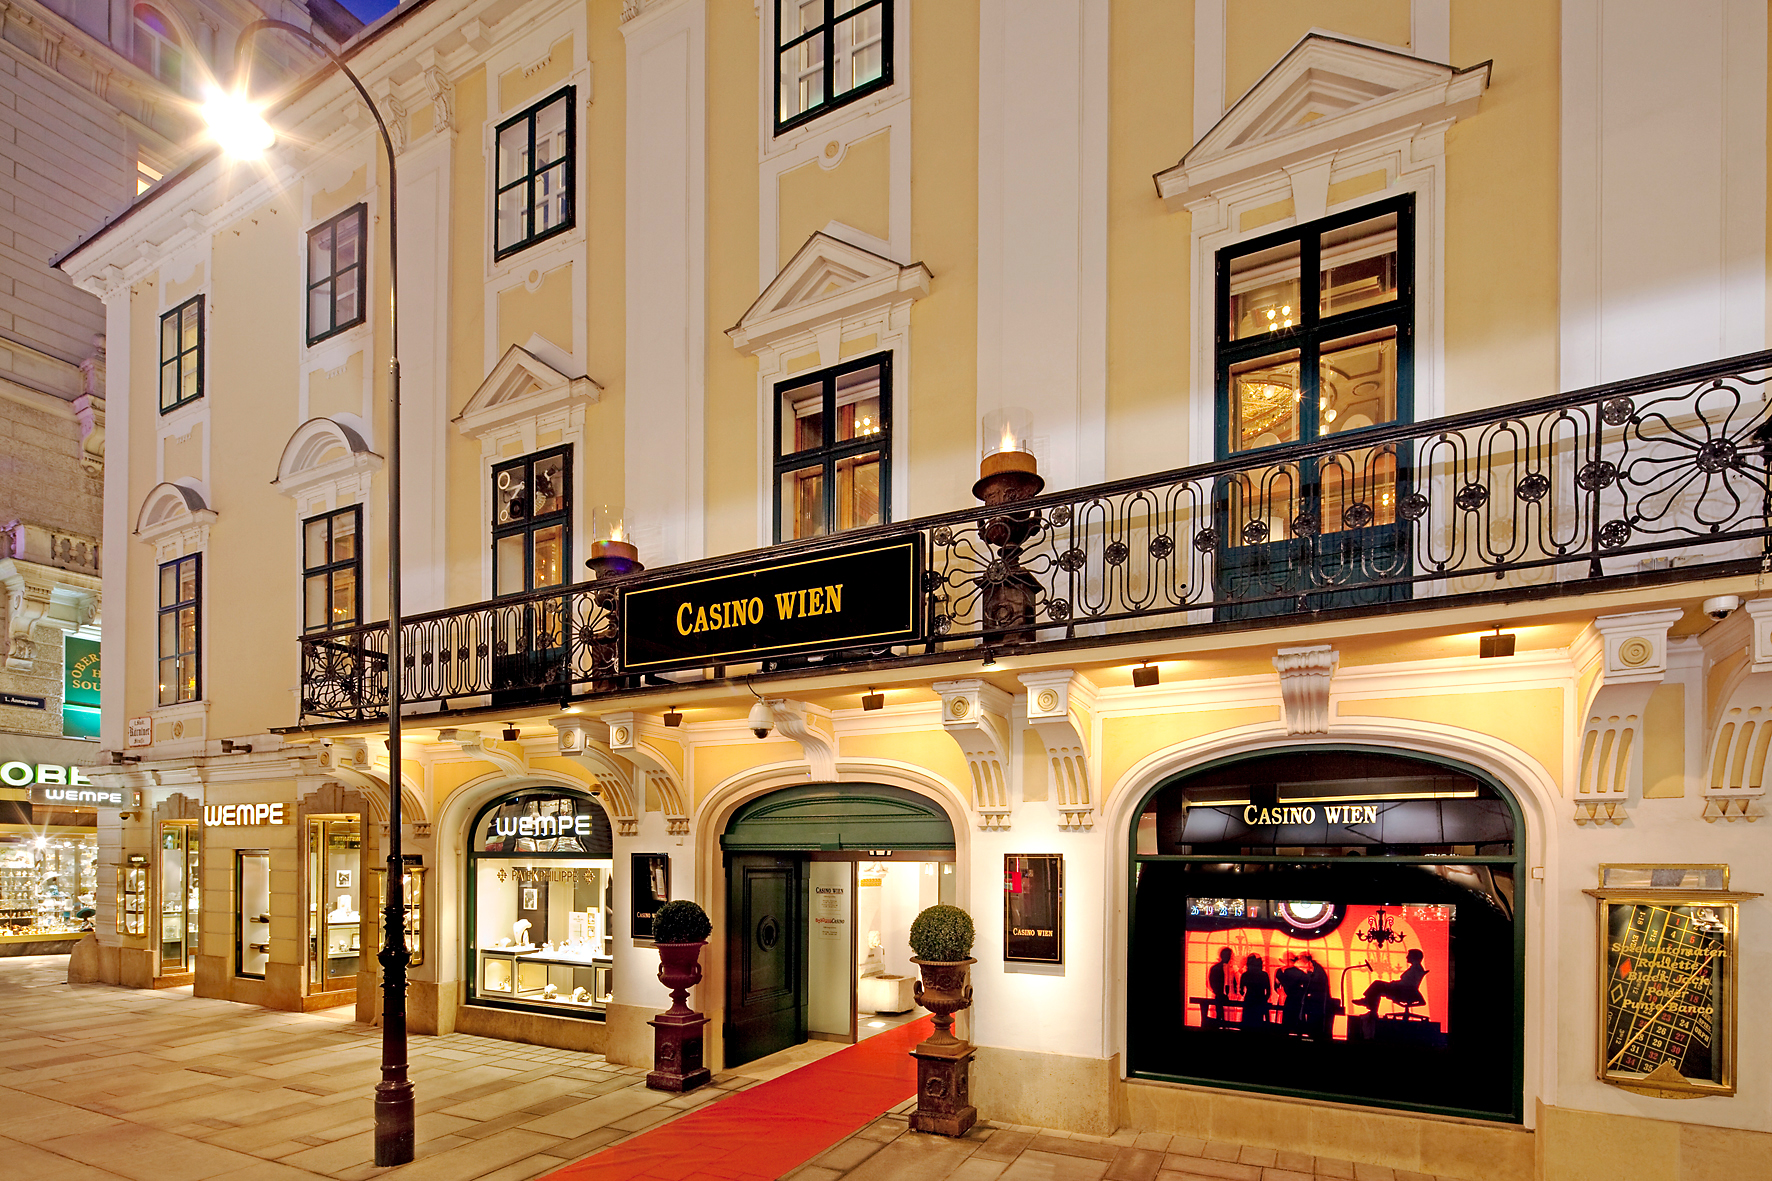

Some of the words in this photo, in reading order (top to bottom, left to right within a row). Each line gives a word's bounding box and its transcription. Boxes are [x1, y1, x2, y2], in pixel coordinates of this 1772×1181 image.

[676, 597, 764, 636] CASINO
[775, 583, 844, 620] WIEN
[71, 652, 101, 678] OBER
[45, 789, 122, 803] WEMPE
[203, 803, 284, 827] WEMPE
[1243, 804, 1316, 825] CASINO
[1324, 805, 1378, 824] WIEN
[496, 815, 593, 836] WEMPE
[540, 870, 579, 882] PHILIPPE
[1012, 927, 1035, 936] CASINO
[1037, 929, 1053, 937] WIEN
[1611, 942, 1728, 958] Spielautomaten
[1637, 957, 1699, 971] Roulette
[1626, 971, 1669, 983] Black
[1673, 974, 1710, 986] Jack
[1646, 987, 1690, 999] Poker
[1689, 994, 1699, 1003] 18
[1622, 999, 1663, 1011] Punto
[1668, 1001, 1714, 1015] Banco
[1661, 1012, 1672, 1022] 23
[1679, 1019, 1690, 1029] 24
[1656, 1026, 1667, 1035] 26
[1675, 1032, 1685, 1042] 27
[1630, 1045, 1640, 1054] 31
[1648, 1050, 1659, 1060] 32
[1652, 1038, 1662, 1048] 29
[1671, 1045, 1680, 1054] 30
[1643, 1062, 1653, 1072] 35
